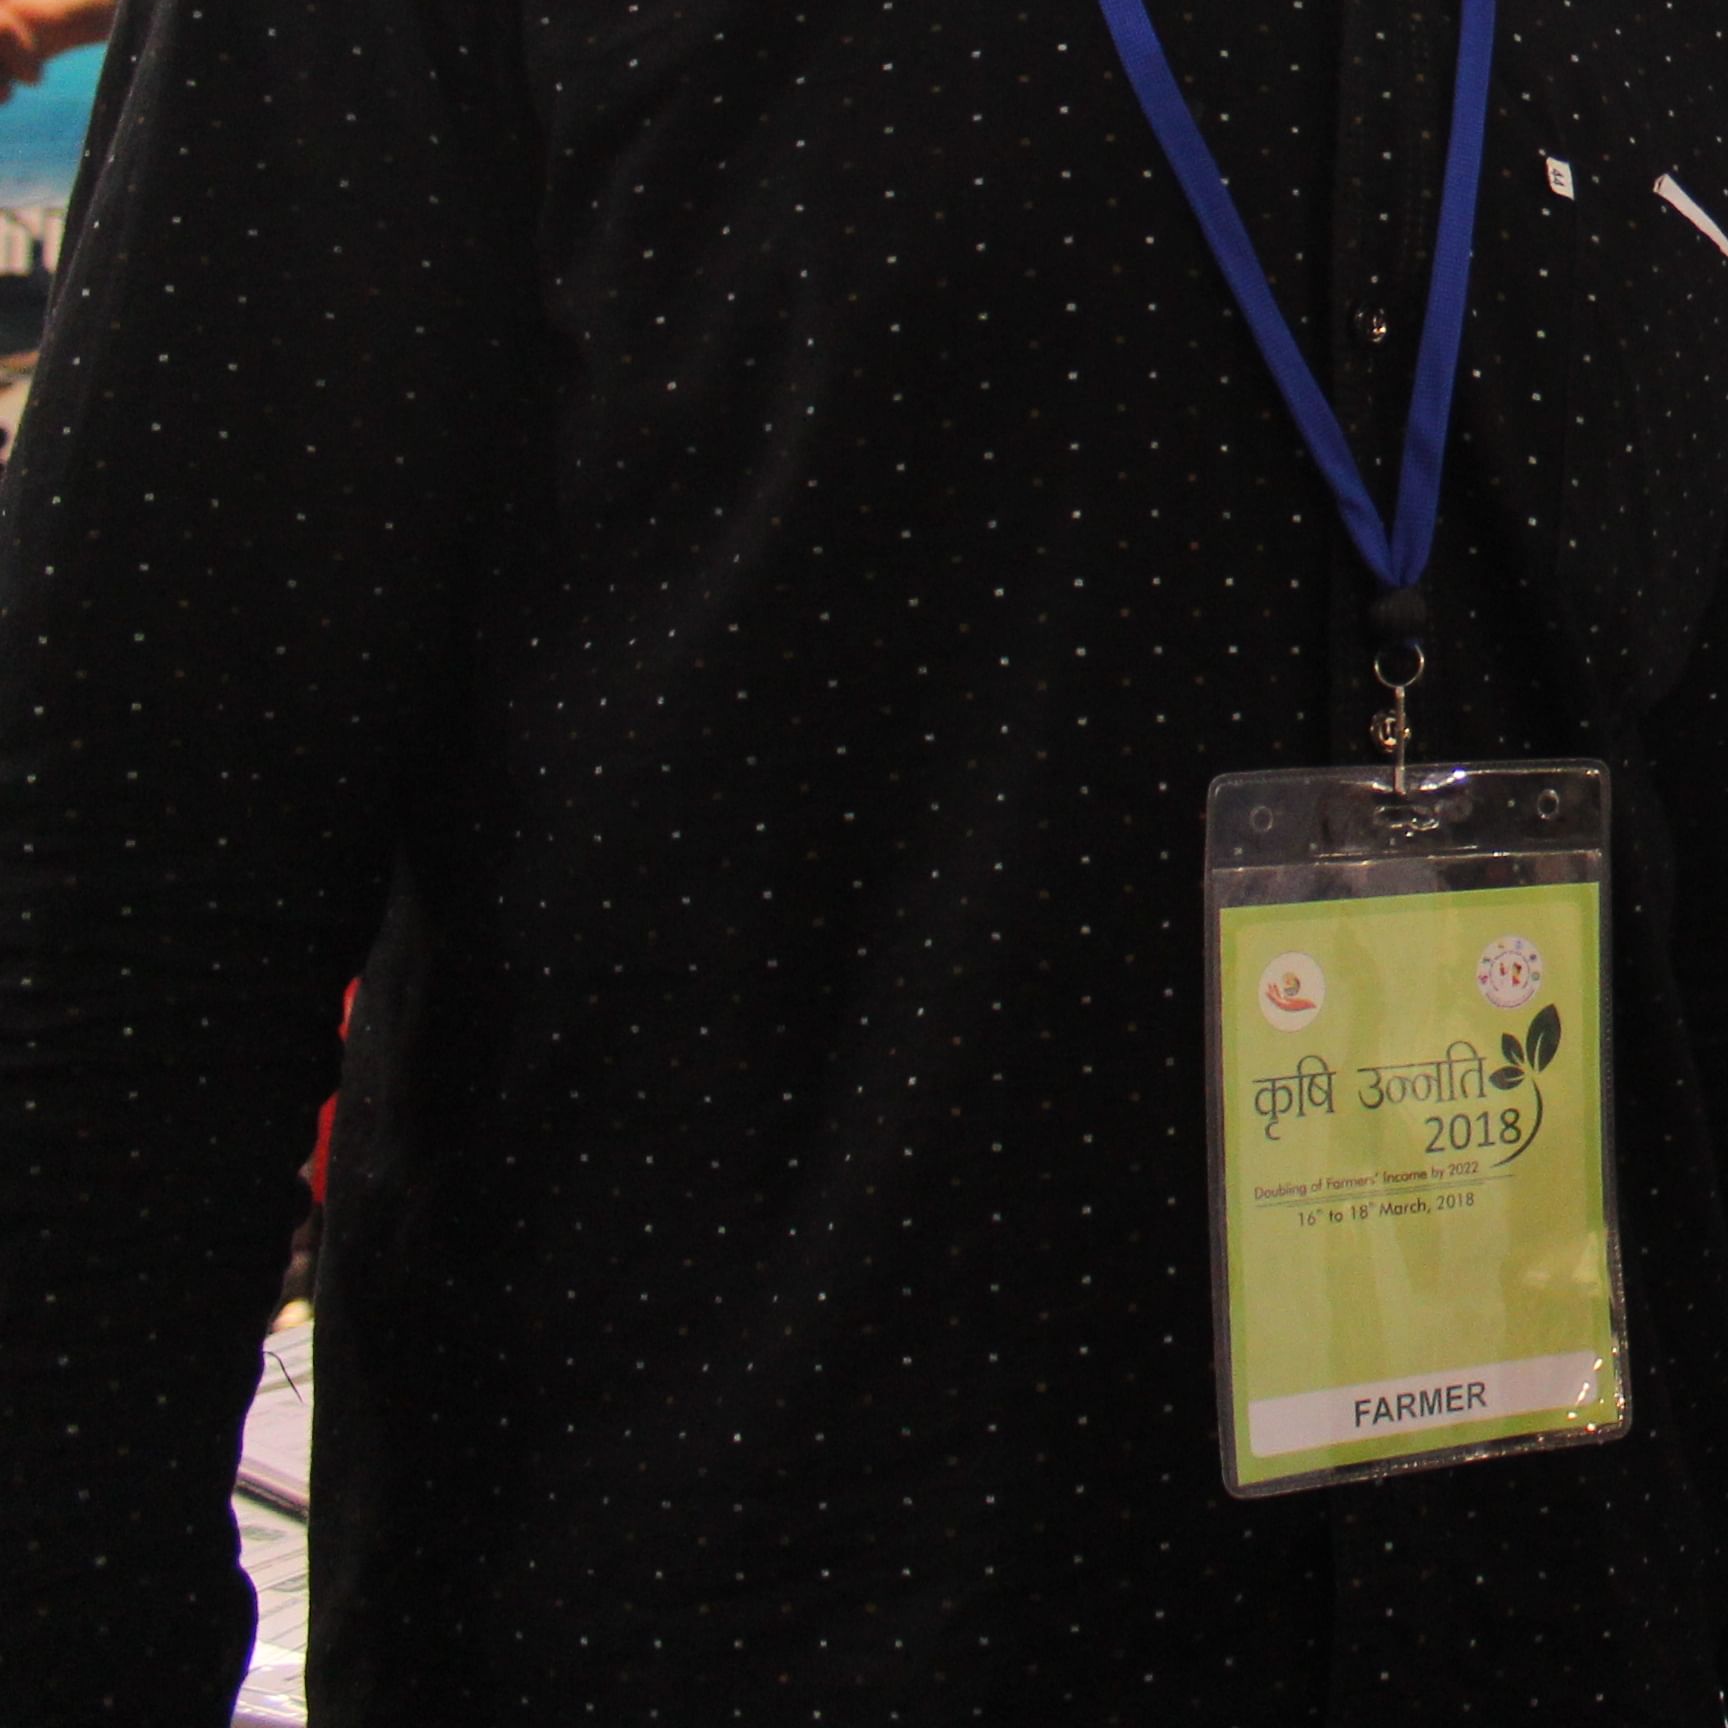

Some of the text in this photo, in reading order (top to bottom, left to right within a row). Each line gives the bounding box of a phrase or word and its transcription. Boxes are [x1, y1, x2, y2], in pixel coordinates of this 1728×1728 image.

[1252, 1055, 1337, 1141] कृषि
[1424, 1107, 1523, 1155] 2018
[1254, 1160, 1480, 1201] Doubling of Farmers' Income by 2022
[1328, 1209, 1344, 1224] to
[1379, 1197, 1432, 1217] March,
[1436, 1191, 1475, 1210] 2018
[1354, 1381, 1488, 1428] FARMER
